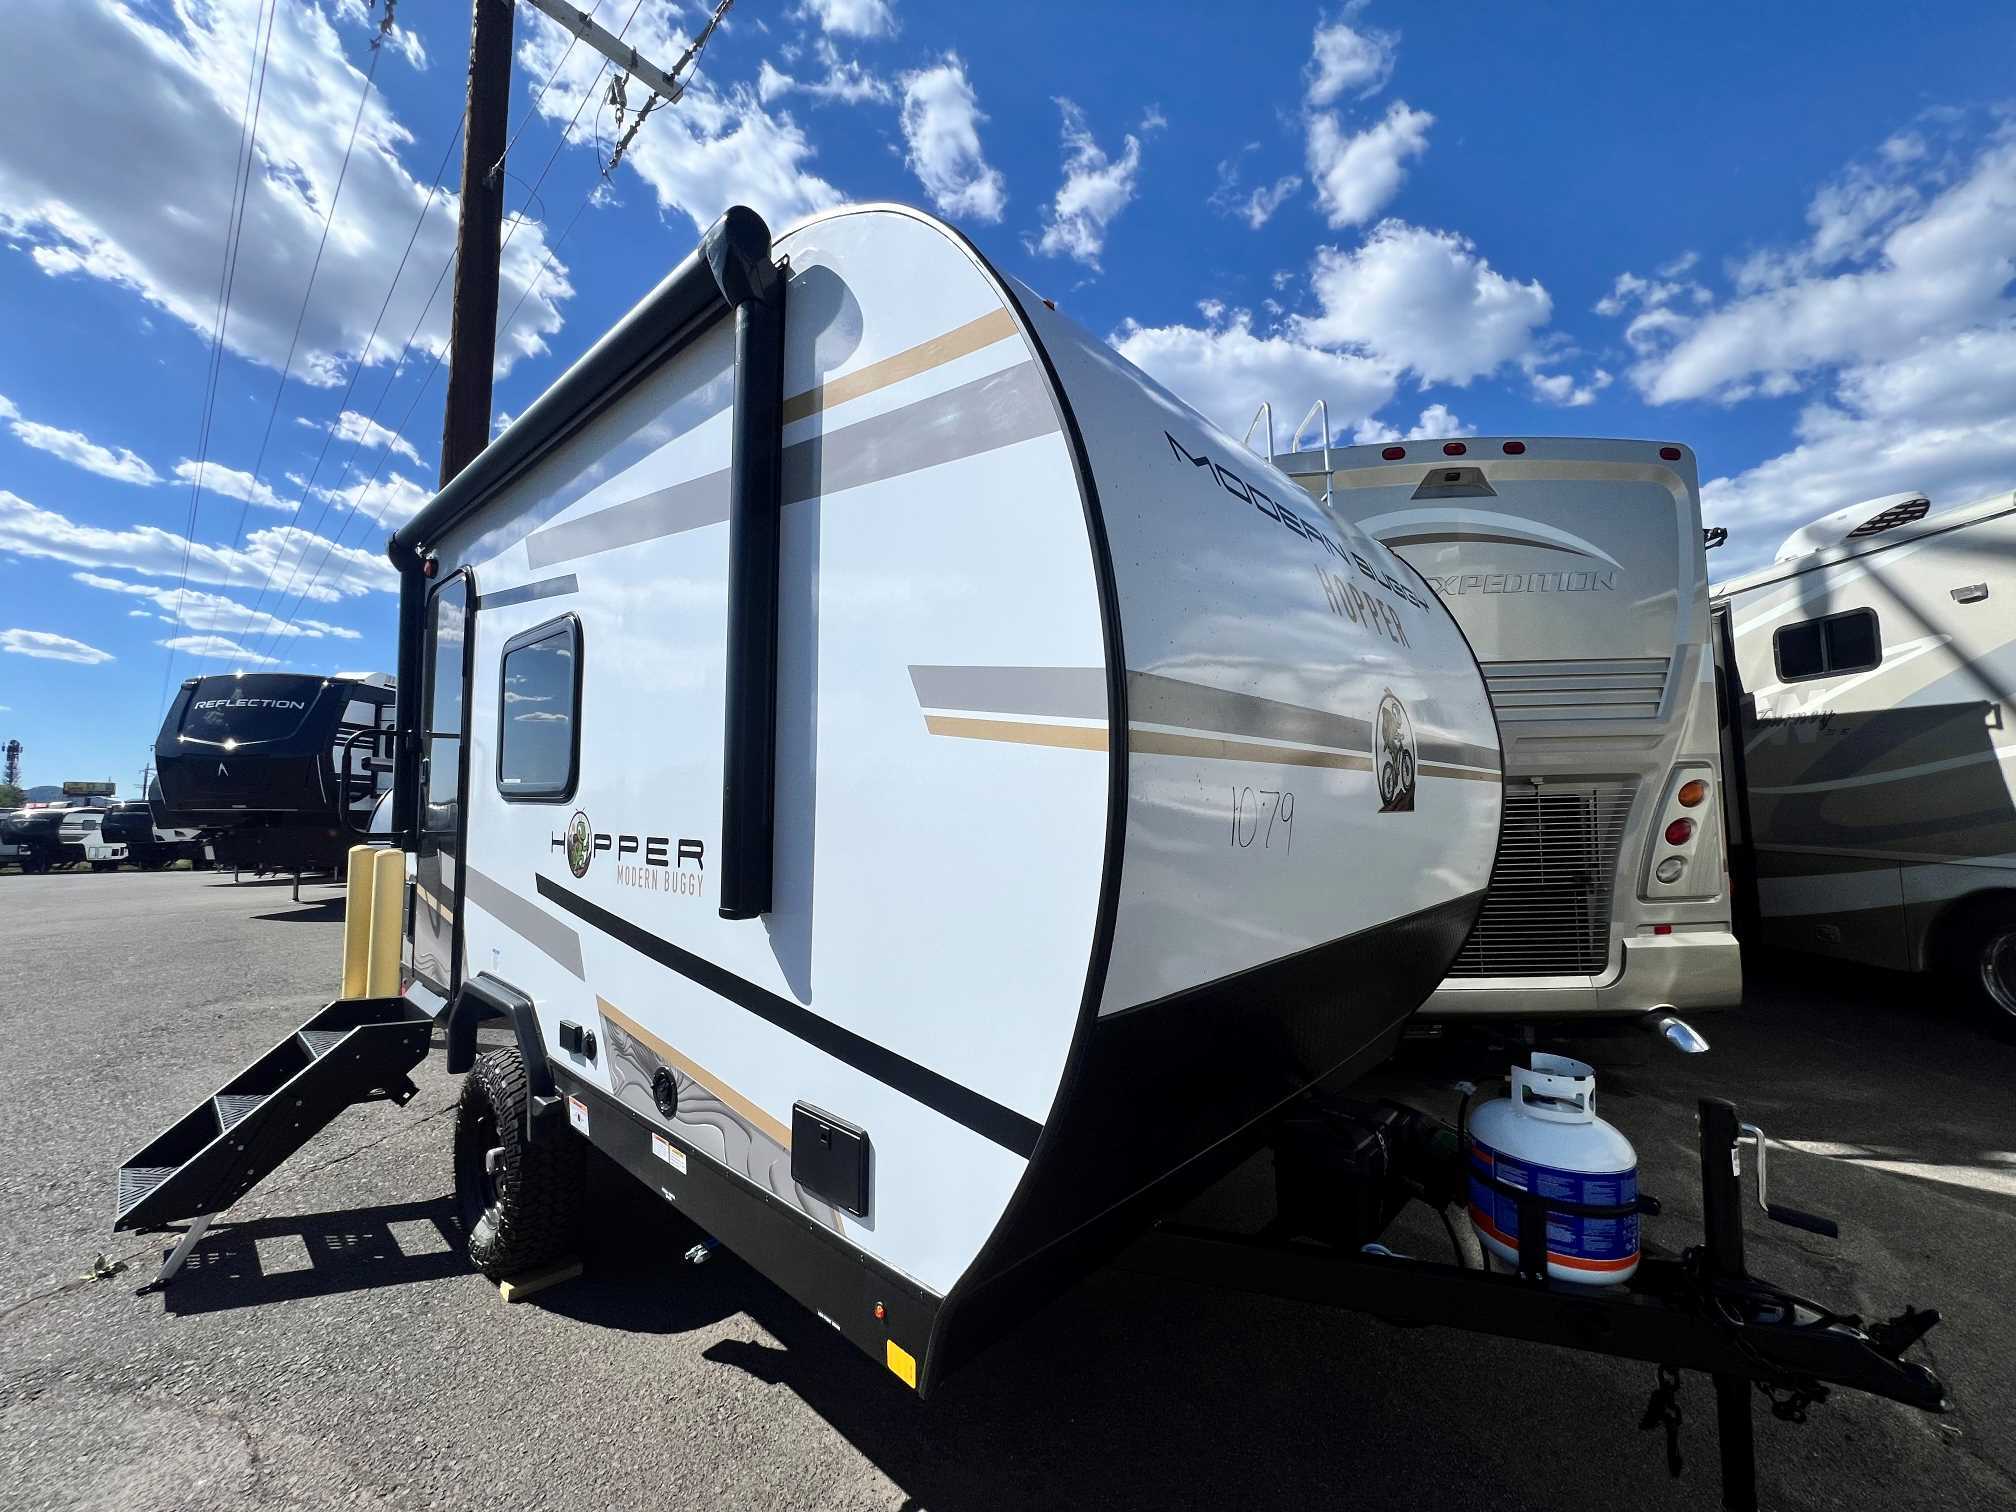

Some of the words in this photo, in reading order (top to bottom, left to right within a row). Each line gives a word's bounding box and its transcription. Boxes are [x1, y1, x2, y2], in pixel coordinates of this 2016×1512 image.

[1165, 430, 1351, 567] MODERN
[1351, 551, 1430, 613] BUGGY
[1313, 563, 1411, 649] HOPPER
[1427, 571, 1616, 595] XPEDITION
[194, 699, 305, 710] REFLECTION
[551, 810, 705, 879] HOPPER
[1231, 786, 1295, 856] 1079
[616, 865, 658, 891] MODERN
[664, 870, 704, 897] BUGGY
